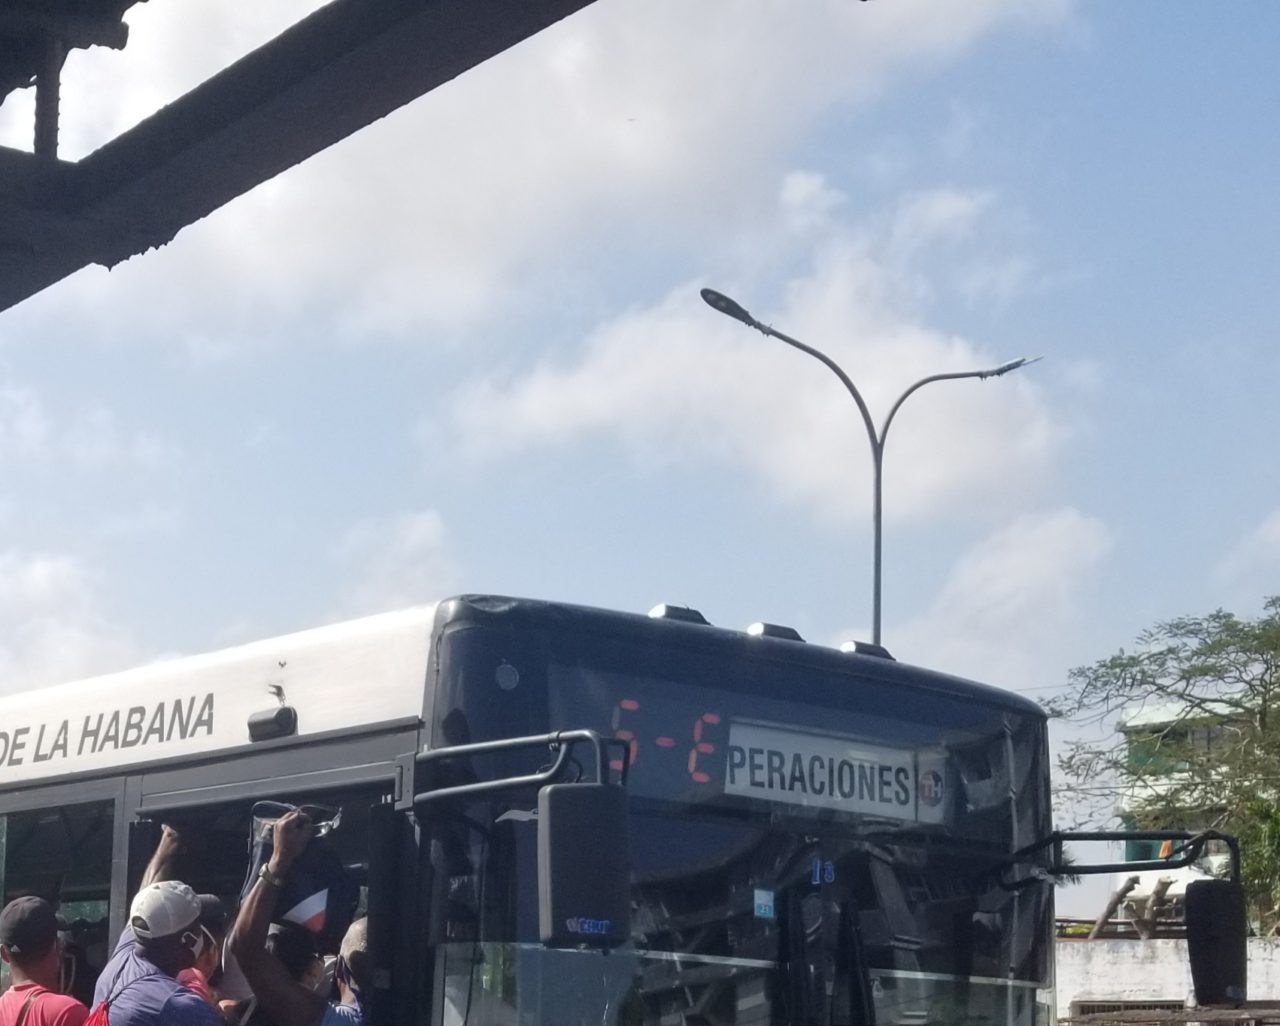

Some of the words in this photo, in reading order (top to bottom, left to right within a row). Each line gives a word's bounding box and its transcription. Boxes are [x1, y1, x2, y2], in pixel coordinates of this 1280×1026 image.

[33, 720, 69, 763] LA
[77, 693, 214, 755] HABANA
[728, 746, 910, 806] PERACIONES
